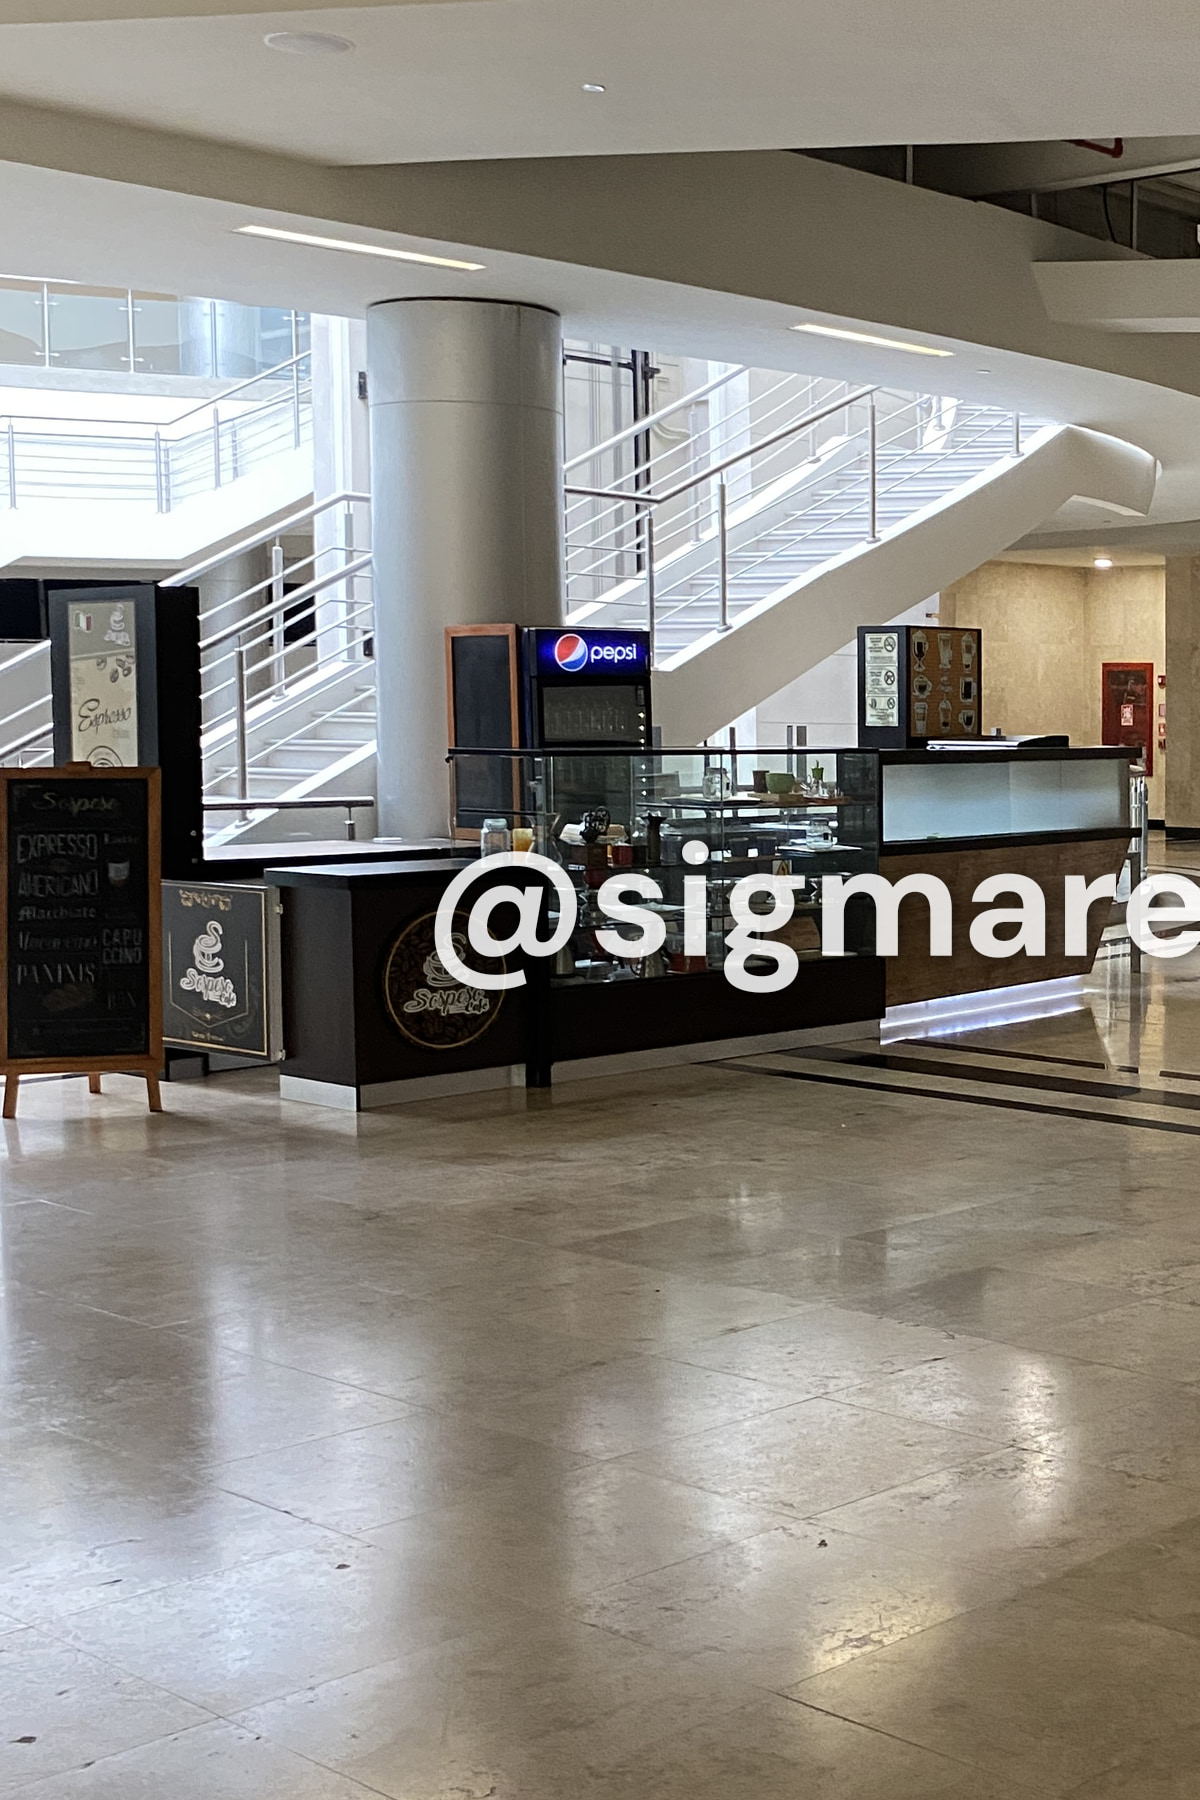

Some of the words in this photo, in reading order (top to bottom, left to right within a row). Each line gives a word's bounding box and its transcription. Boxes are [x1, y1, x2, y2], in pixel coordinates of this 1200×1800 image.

[591, 643, 637, 663] pepsi
[78, 698, 131, 735] Espresso
[17, 833, 98, 864] EXPRESSO
[18, 869, 99, 898] AMERICANO
